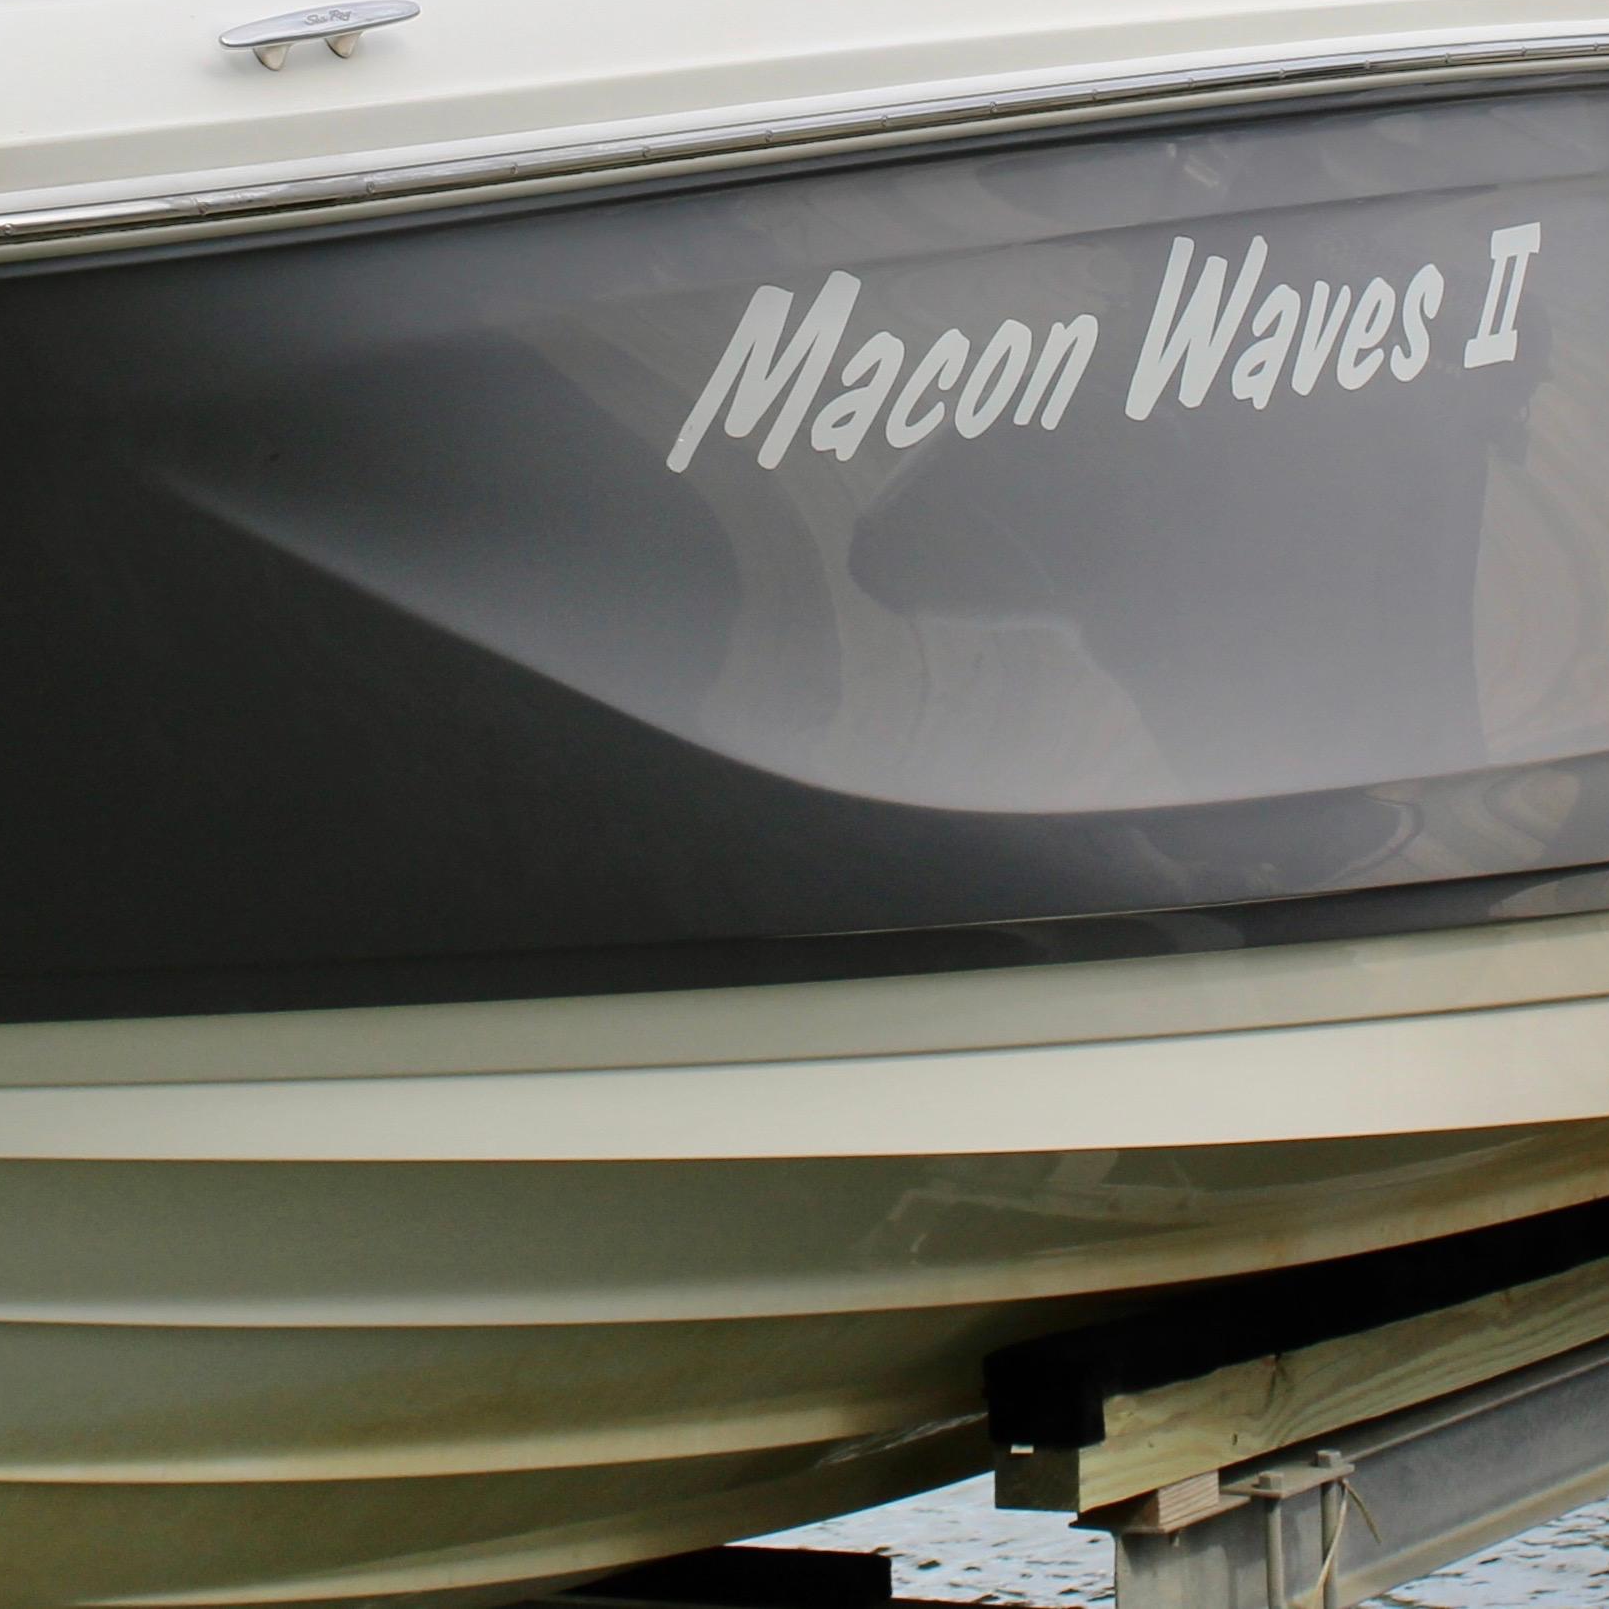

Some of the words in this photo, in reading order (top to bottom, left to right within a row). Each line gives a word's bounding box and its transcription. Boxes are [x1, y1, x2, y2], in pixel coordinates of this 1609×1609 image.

[665, 269, 1099, 473] Macon
[1124, 234, 1445, 422] Waves
[1463, 221, 1541, 369] II
